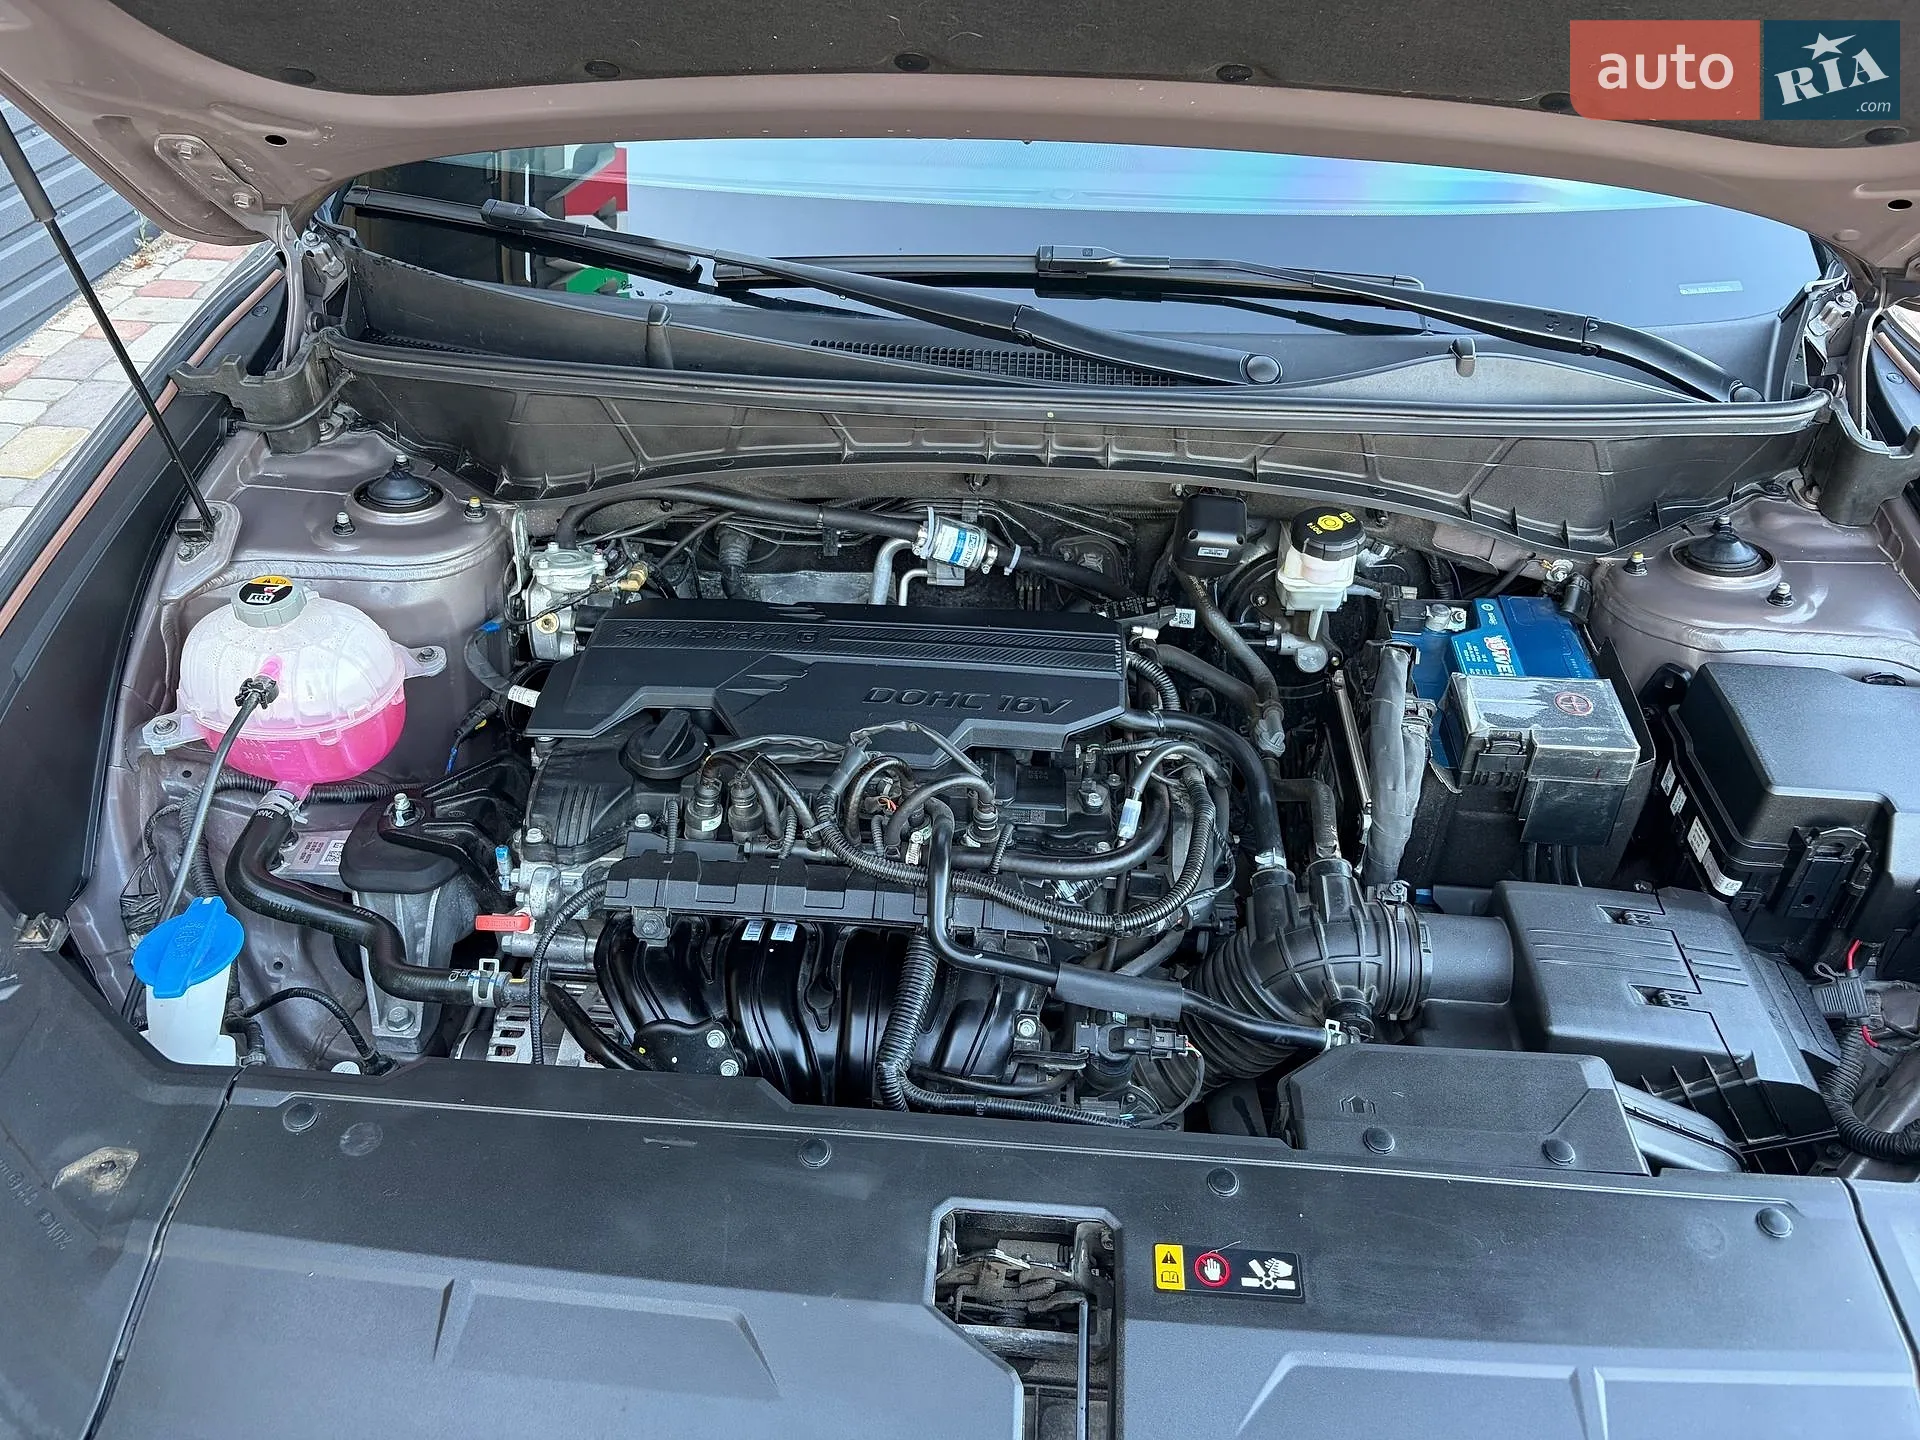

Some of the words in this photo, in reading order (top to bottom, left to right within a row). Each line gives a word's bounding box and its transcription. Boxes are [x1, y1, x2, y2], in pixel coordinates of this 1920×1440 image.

[616, 626, 789, 642] Smartstream
[862, 687, 990, 711] DOHC
[998, 694, 1073, 716] 16V
